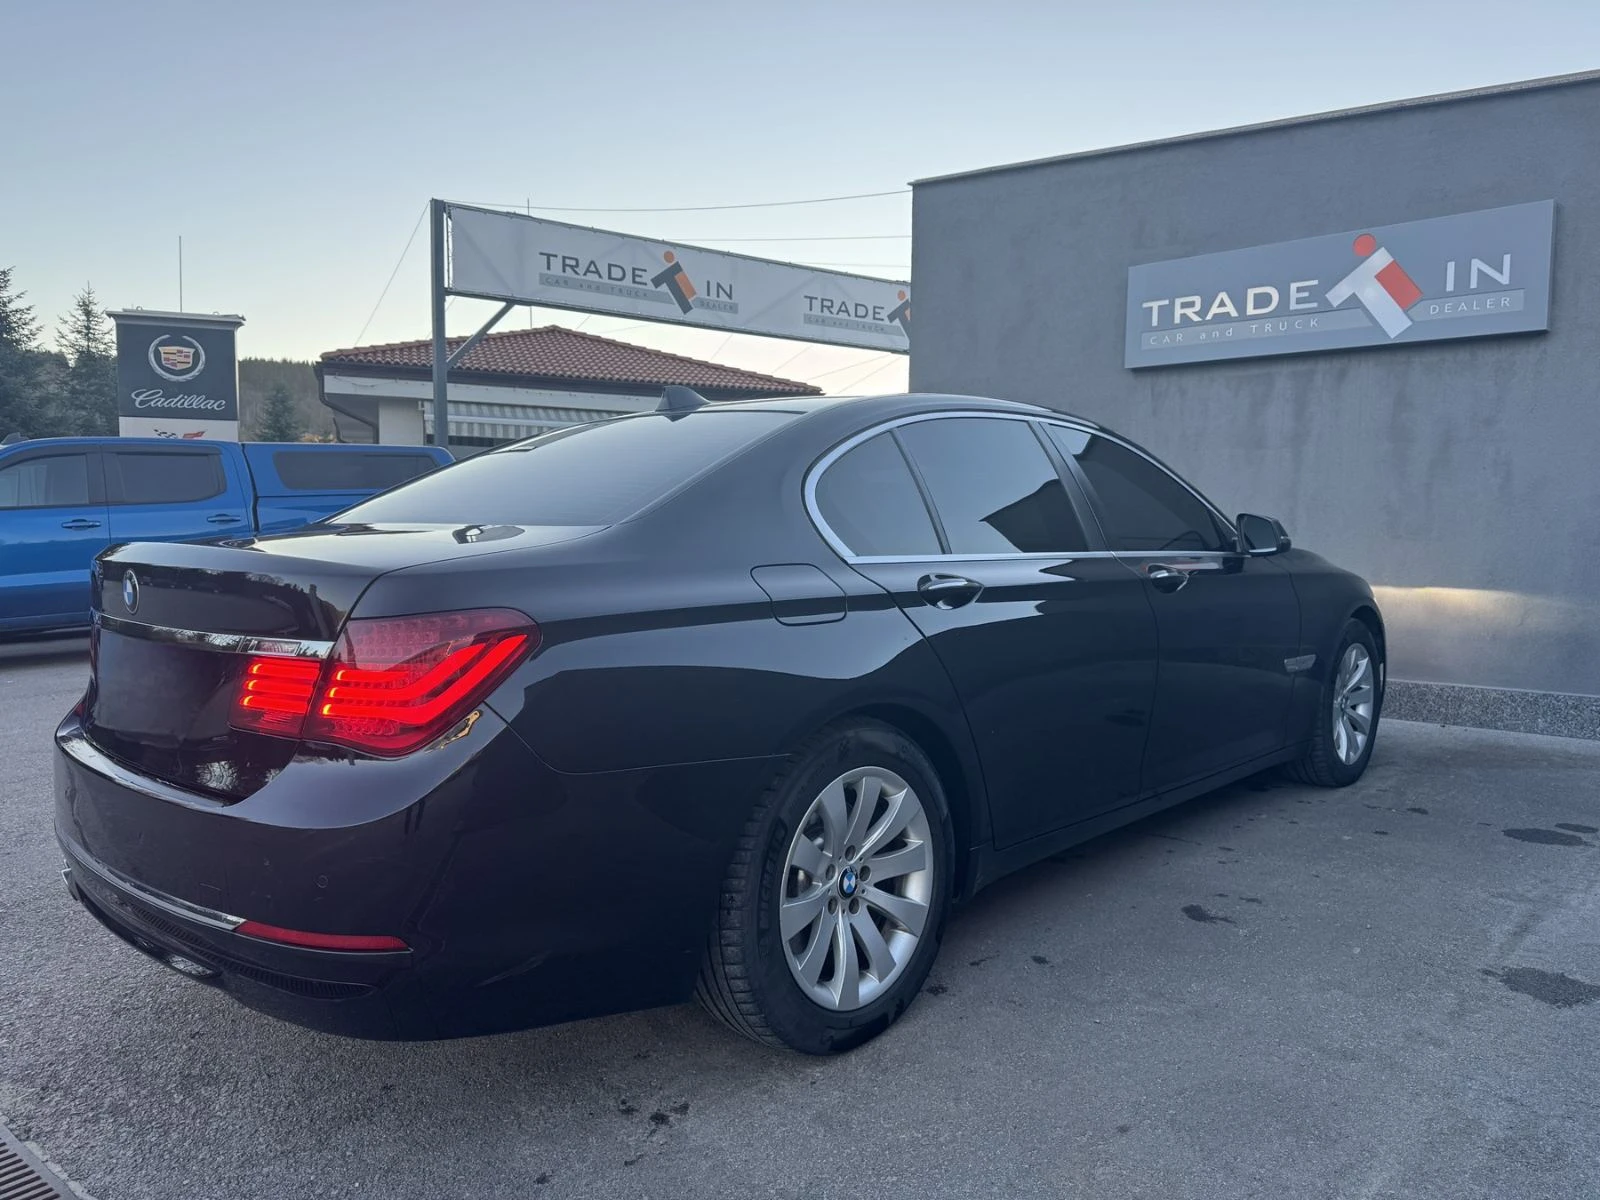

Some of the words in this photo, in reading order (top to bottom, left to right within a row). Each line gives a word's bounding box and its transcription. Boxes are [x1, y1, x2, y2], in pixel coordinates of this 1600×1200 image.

[539, 252, 647, 286] TRADE
[706, 280, 733, 300] IN
[1142, 279, 1319, 327] TRADE
[1446, 254, 1511, 292] IN
[804, 295, 884, 321] TRADE
[1150, 332, 1184, 345] CAR
[1200, 327, 1233, 340] and
[1250, 319, 1320, 334] TRUCK
[1430, 297, 1510, 315] DEALER
[131, 389, 226, 410] Cadillac
